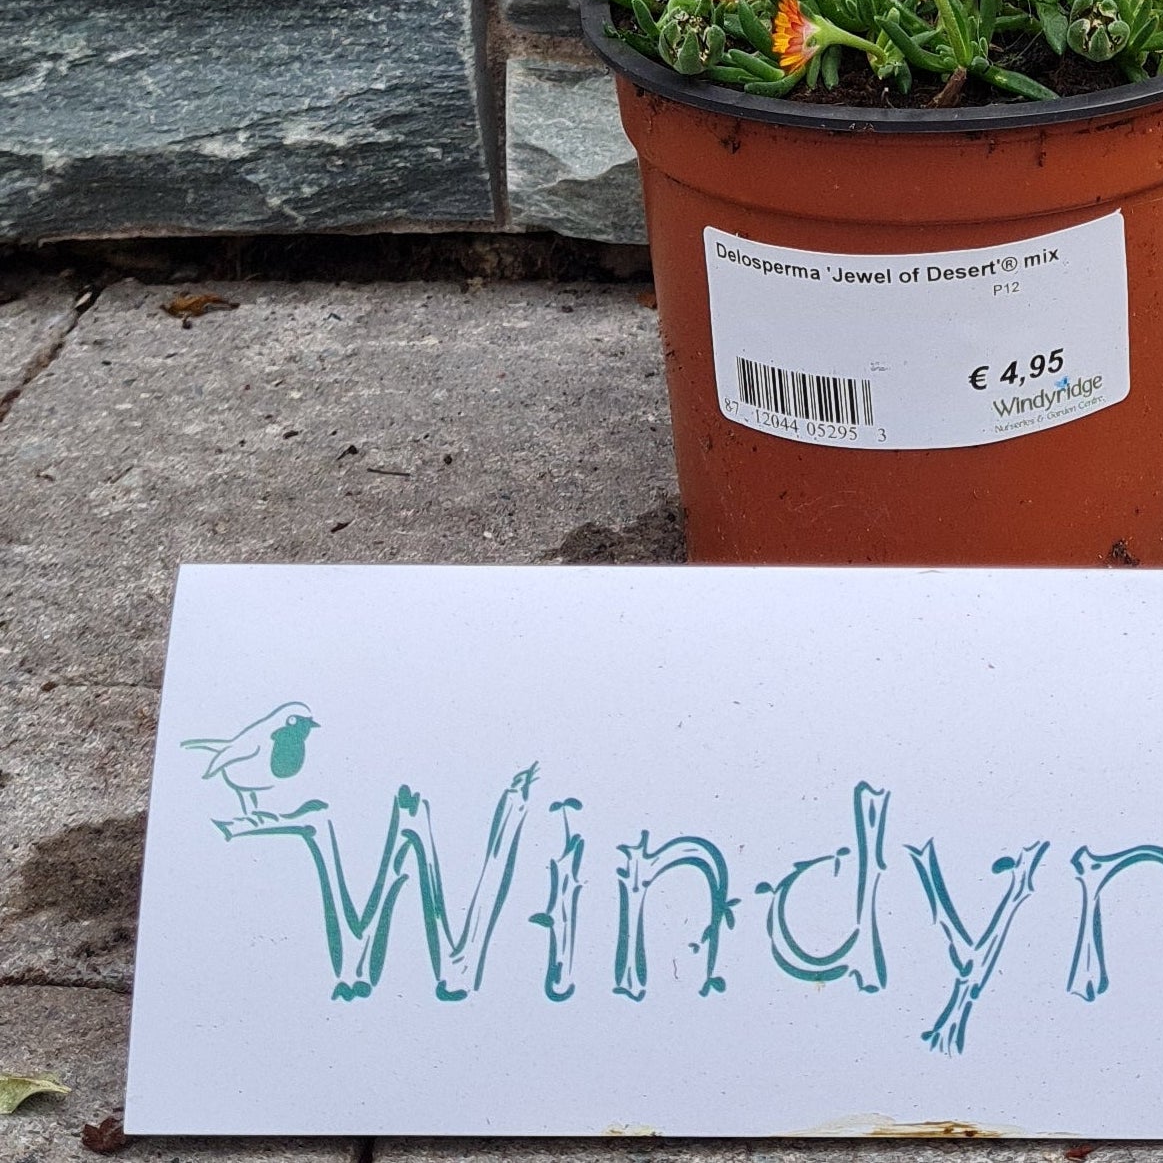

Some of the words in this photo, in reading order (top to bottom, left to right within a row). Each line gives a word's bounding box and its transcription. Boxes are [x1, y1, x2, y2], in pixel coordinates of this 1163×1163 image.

[716, 242, 821, 280] Delosperma
[826, 266, 891, 284] 'Jewel
[899, 267, 919, 283] of
[1024, 248, 1059, 268] mix
[993, 282, 1020, 296] P12
[968, 365, 989, 390] €
[1000, 348, 1064, 387] 4,95
[993, 375, 1103, 418] Windyridge
[806, 422, 858, 440] 05295
[877, 428, 887, 442] 3
